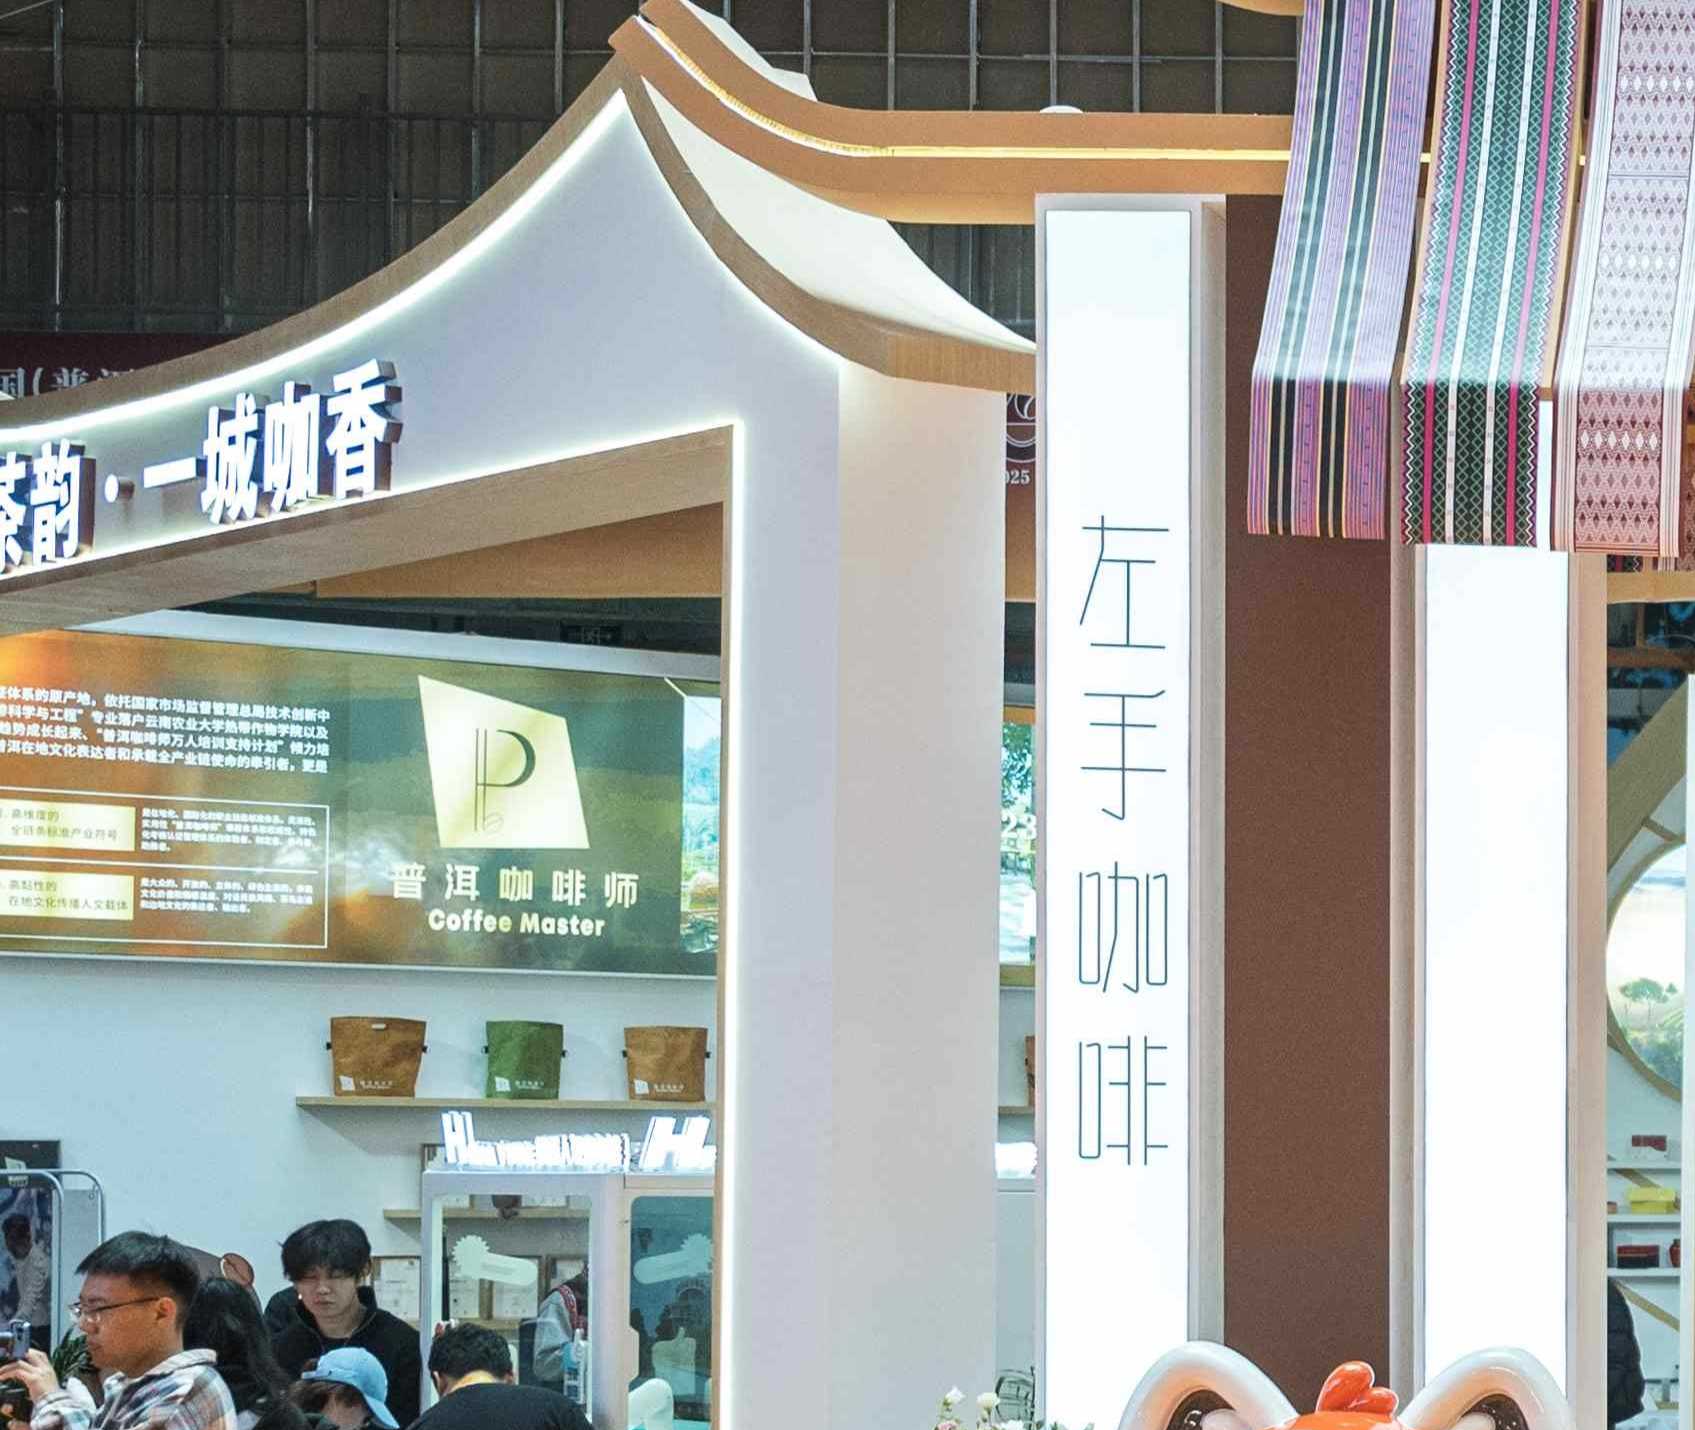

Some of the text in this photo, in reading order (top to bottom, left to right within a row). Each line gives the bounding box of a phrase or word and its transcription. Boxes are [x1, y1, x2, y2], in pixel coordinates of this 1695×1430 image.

[1078, 514, 1170, 1167] 左手咖啡
[391, 862, 639, 909] 普洱咖啡师
[428, 908, 606, 937] Coffee Master
